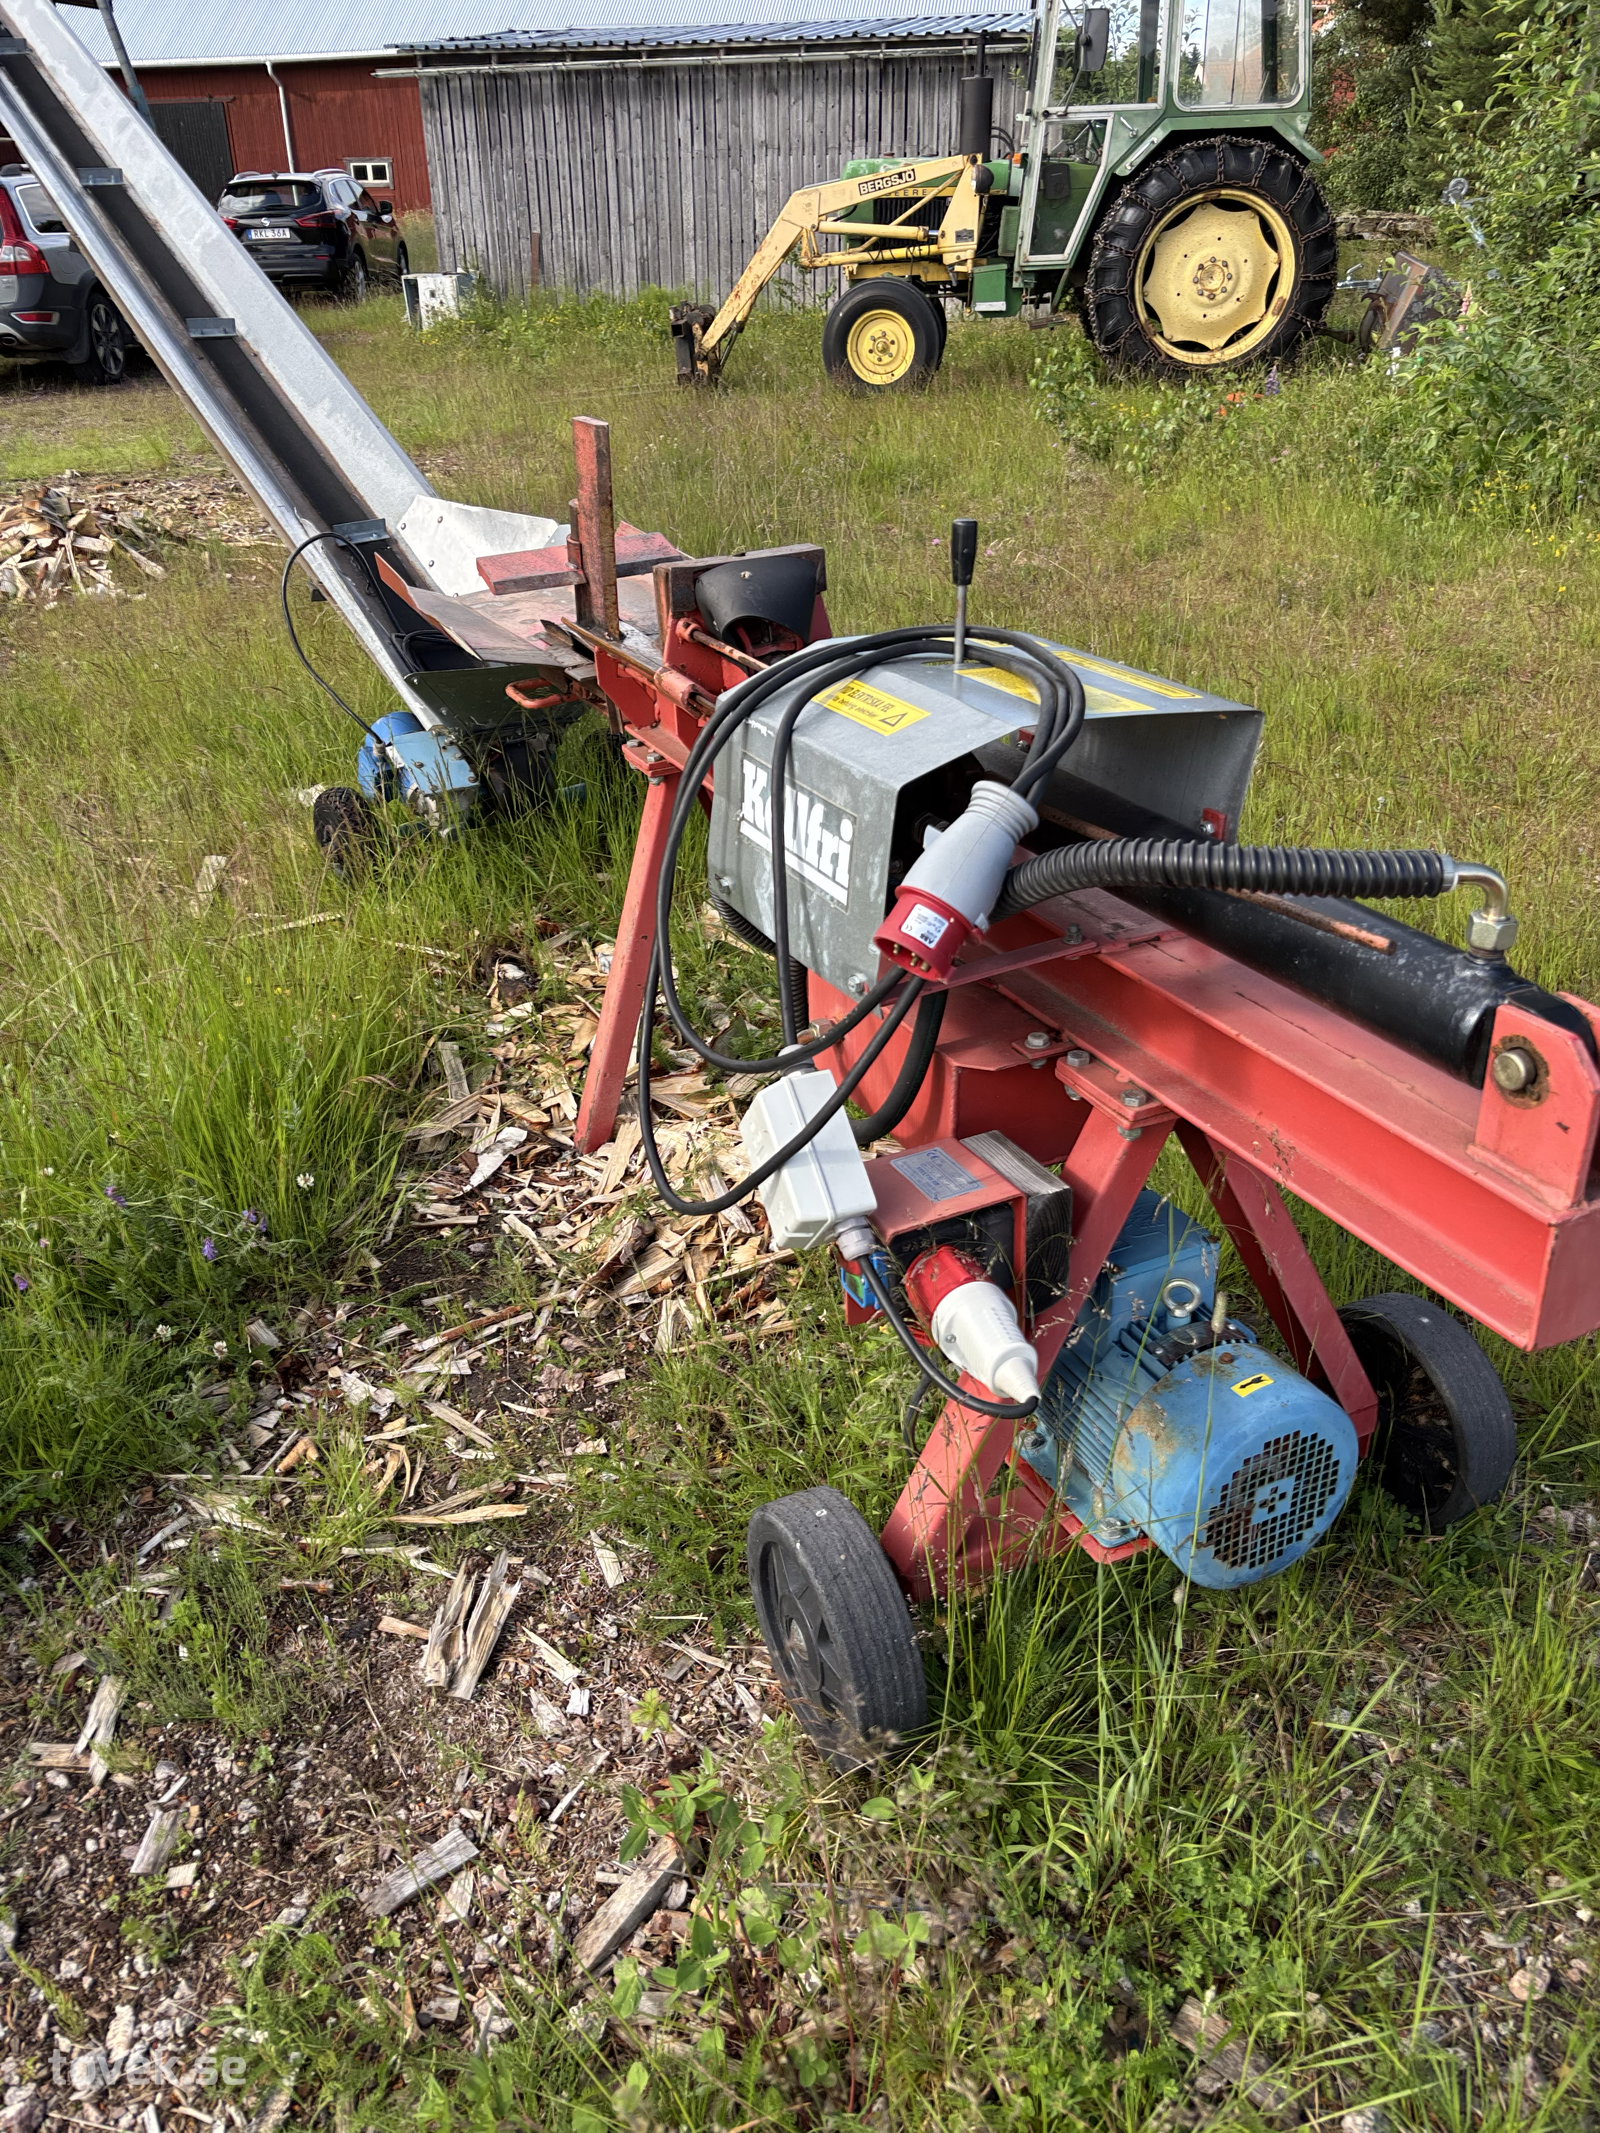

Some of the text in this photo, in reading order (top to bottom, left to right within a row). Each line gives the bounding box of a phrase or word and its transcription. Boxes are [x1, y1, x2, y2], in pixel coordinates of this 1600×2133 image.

[860, 169, 915, 195] BERGSJÖ
[254, 229, 287, 238] RKL 36A
